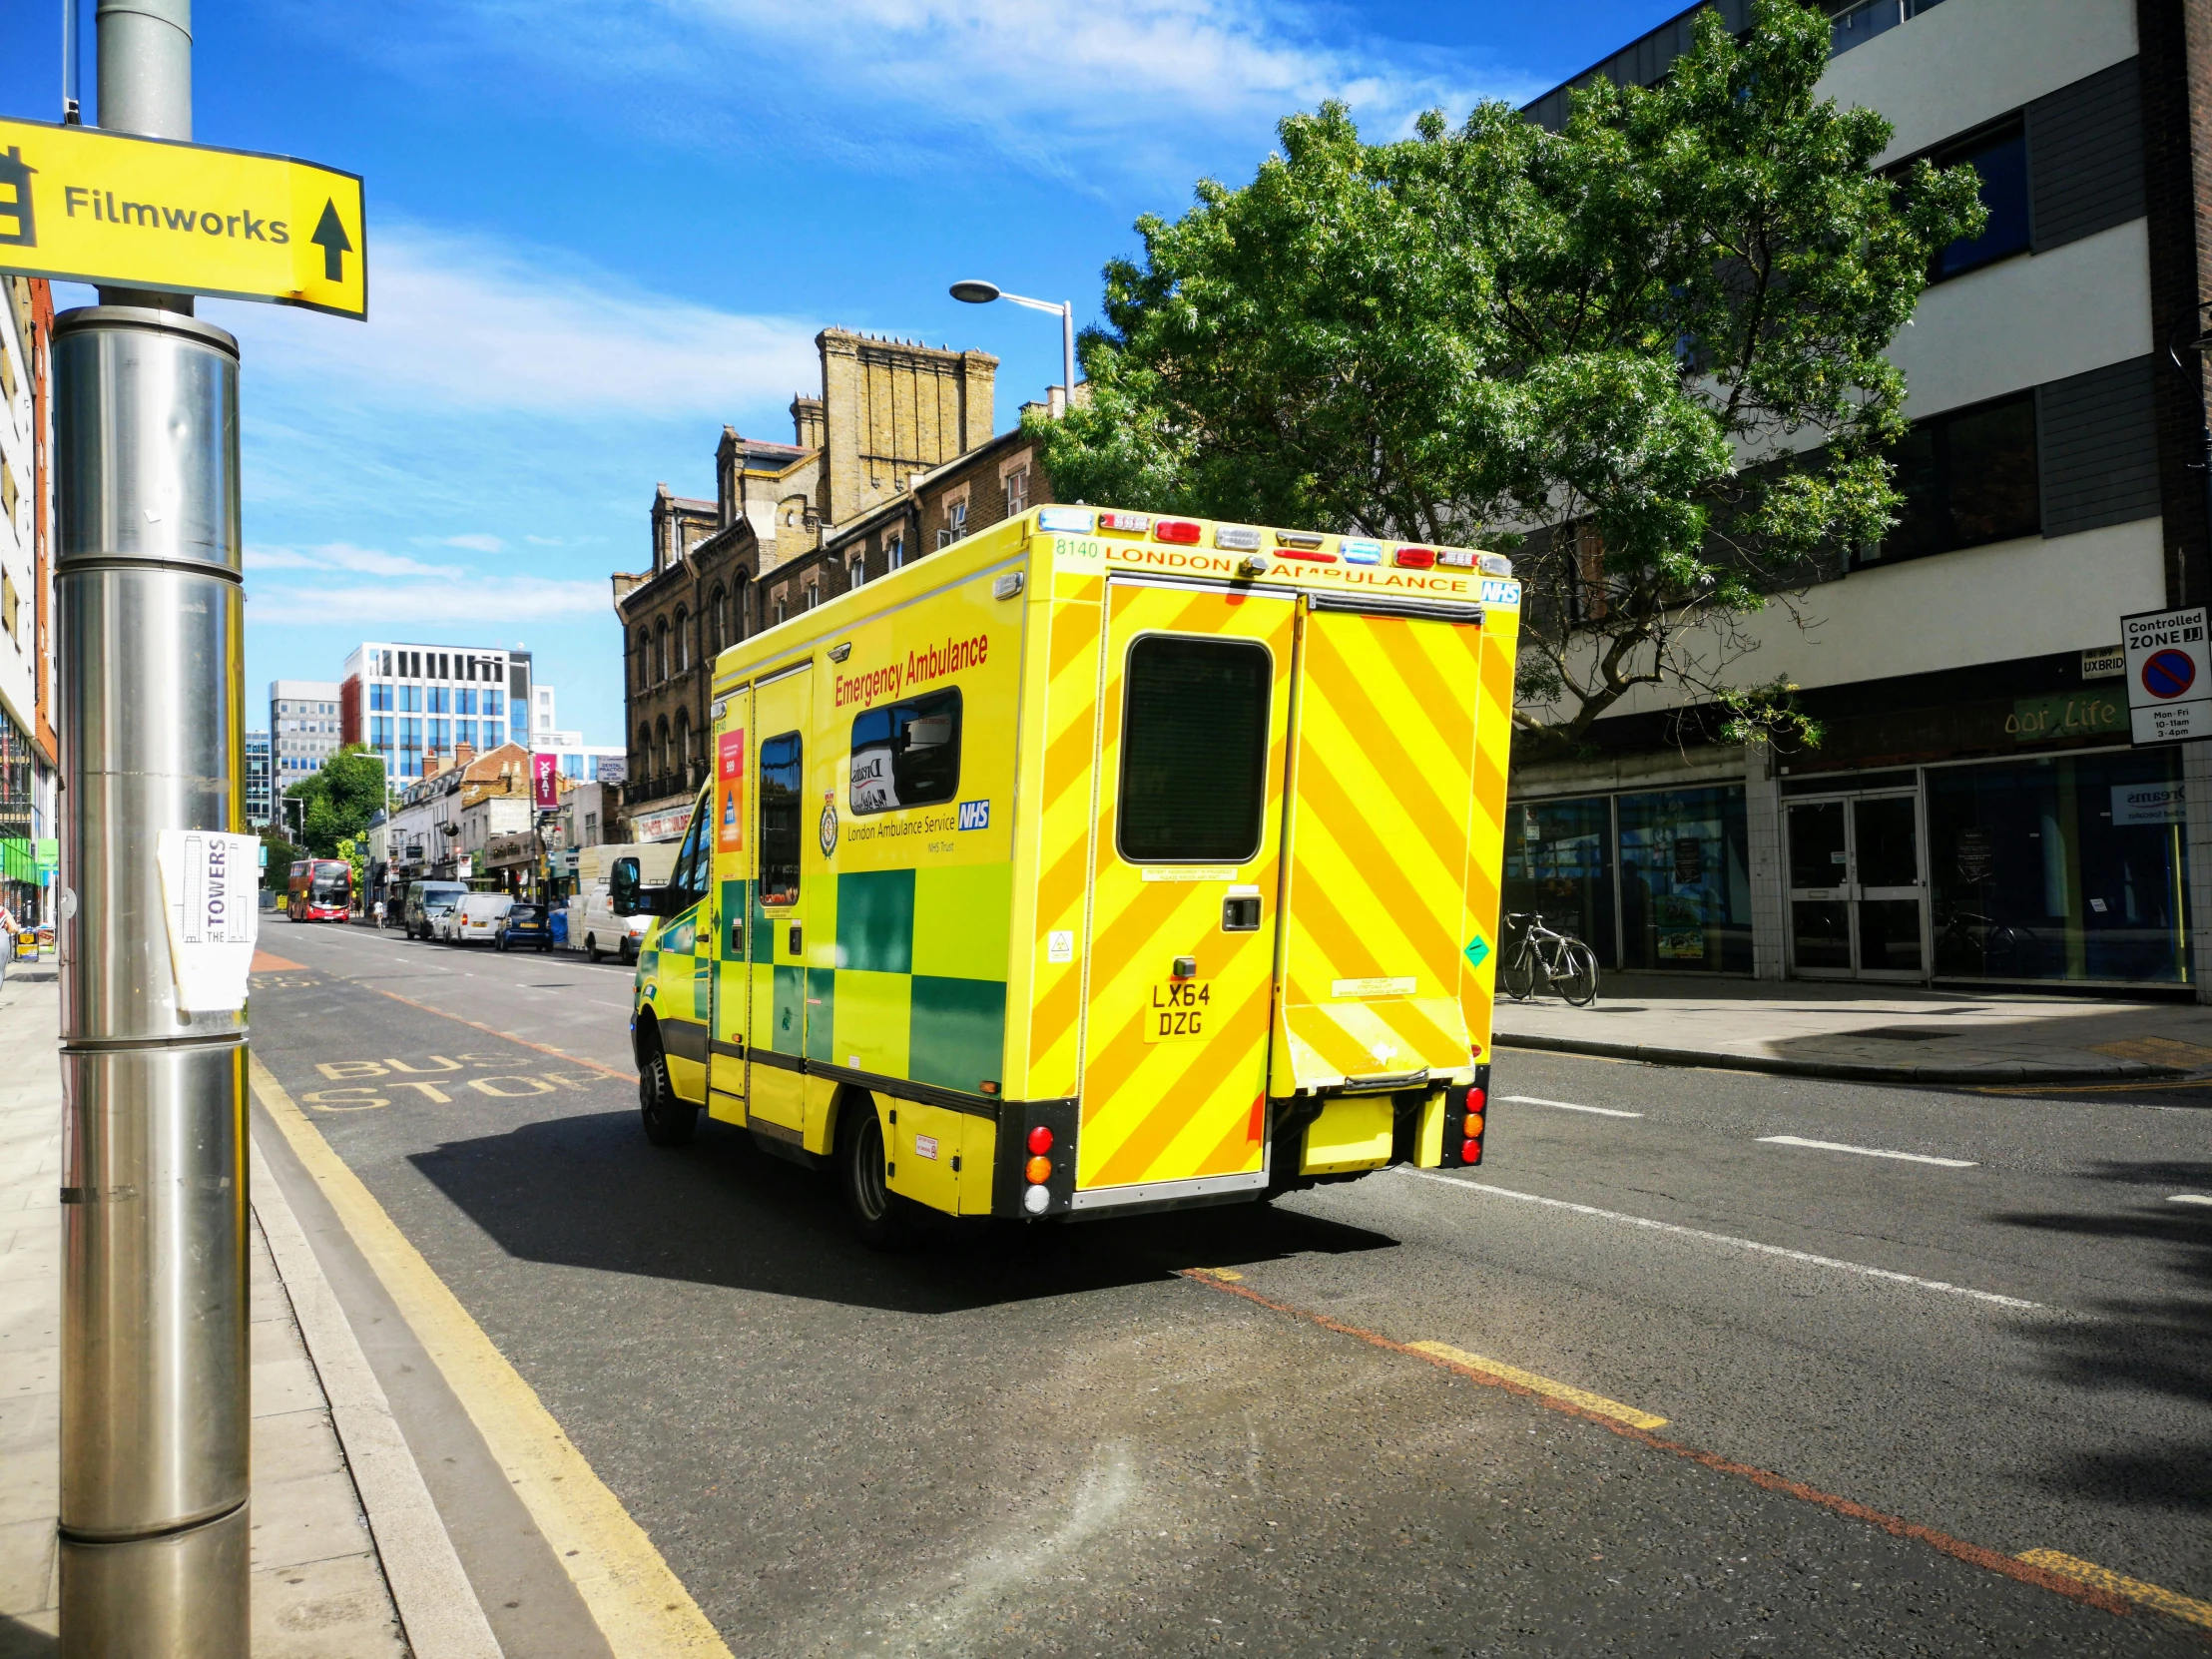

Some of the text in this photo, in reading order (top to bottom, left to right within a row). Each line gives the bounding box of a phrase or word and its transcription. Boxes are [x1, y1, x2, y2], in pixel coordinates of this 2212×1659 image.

[64, 185, 290, 245] Filmworks
[1056, 539, 1098, 558] 8140
[1105, 546, 1231, 572] LONDON
[1482, 582, 1519, 603] NHS
[2128, 612, 2202, 633] Controlled
[2129, 628, 2202, 650] ZONE JJ
[834, 634, 988, 708] Emergency Ambulance
[2065, 700, 2116, 728] Life
[847, 813, 955, 841] London Ambulance Service
[958, 801, 989, 829] NHS
[928, 840, 954, 852] NHS Trust
[208, 838, 226, 927] TOWERS
[207, 931, 224, 943] THE
[1153, 983, 1211, 1008] LX64
[1159, 1011, 1202, 1036] DZG
[314, 1052, 533, 1080] BUS
[301, 1069, 611, 1112] STOP
